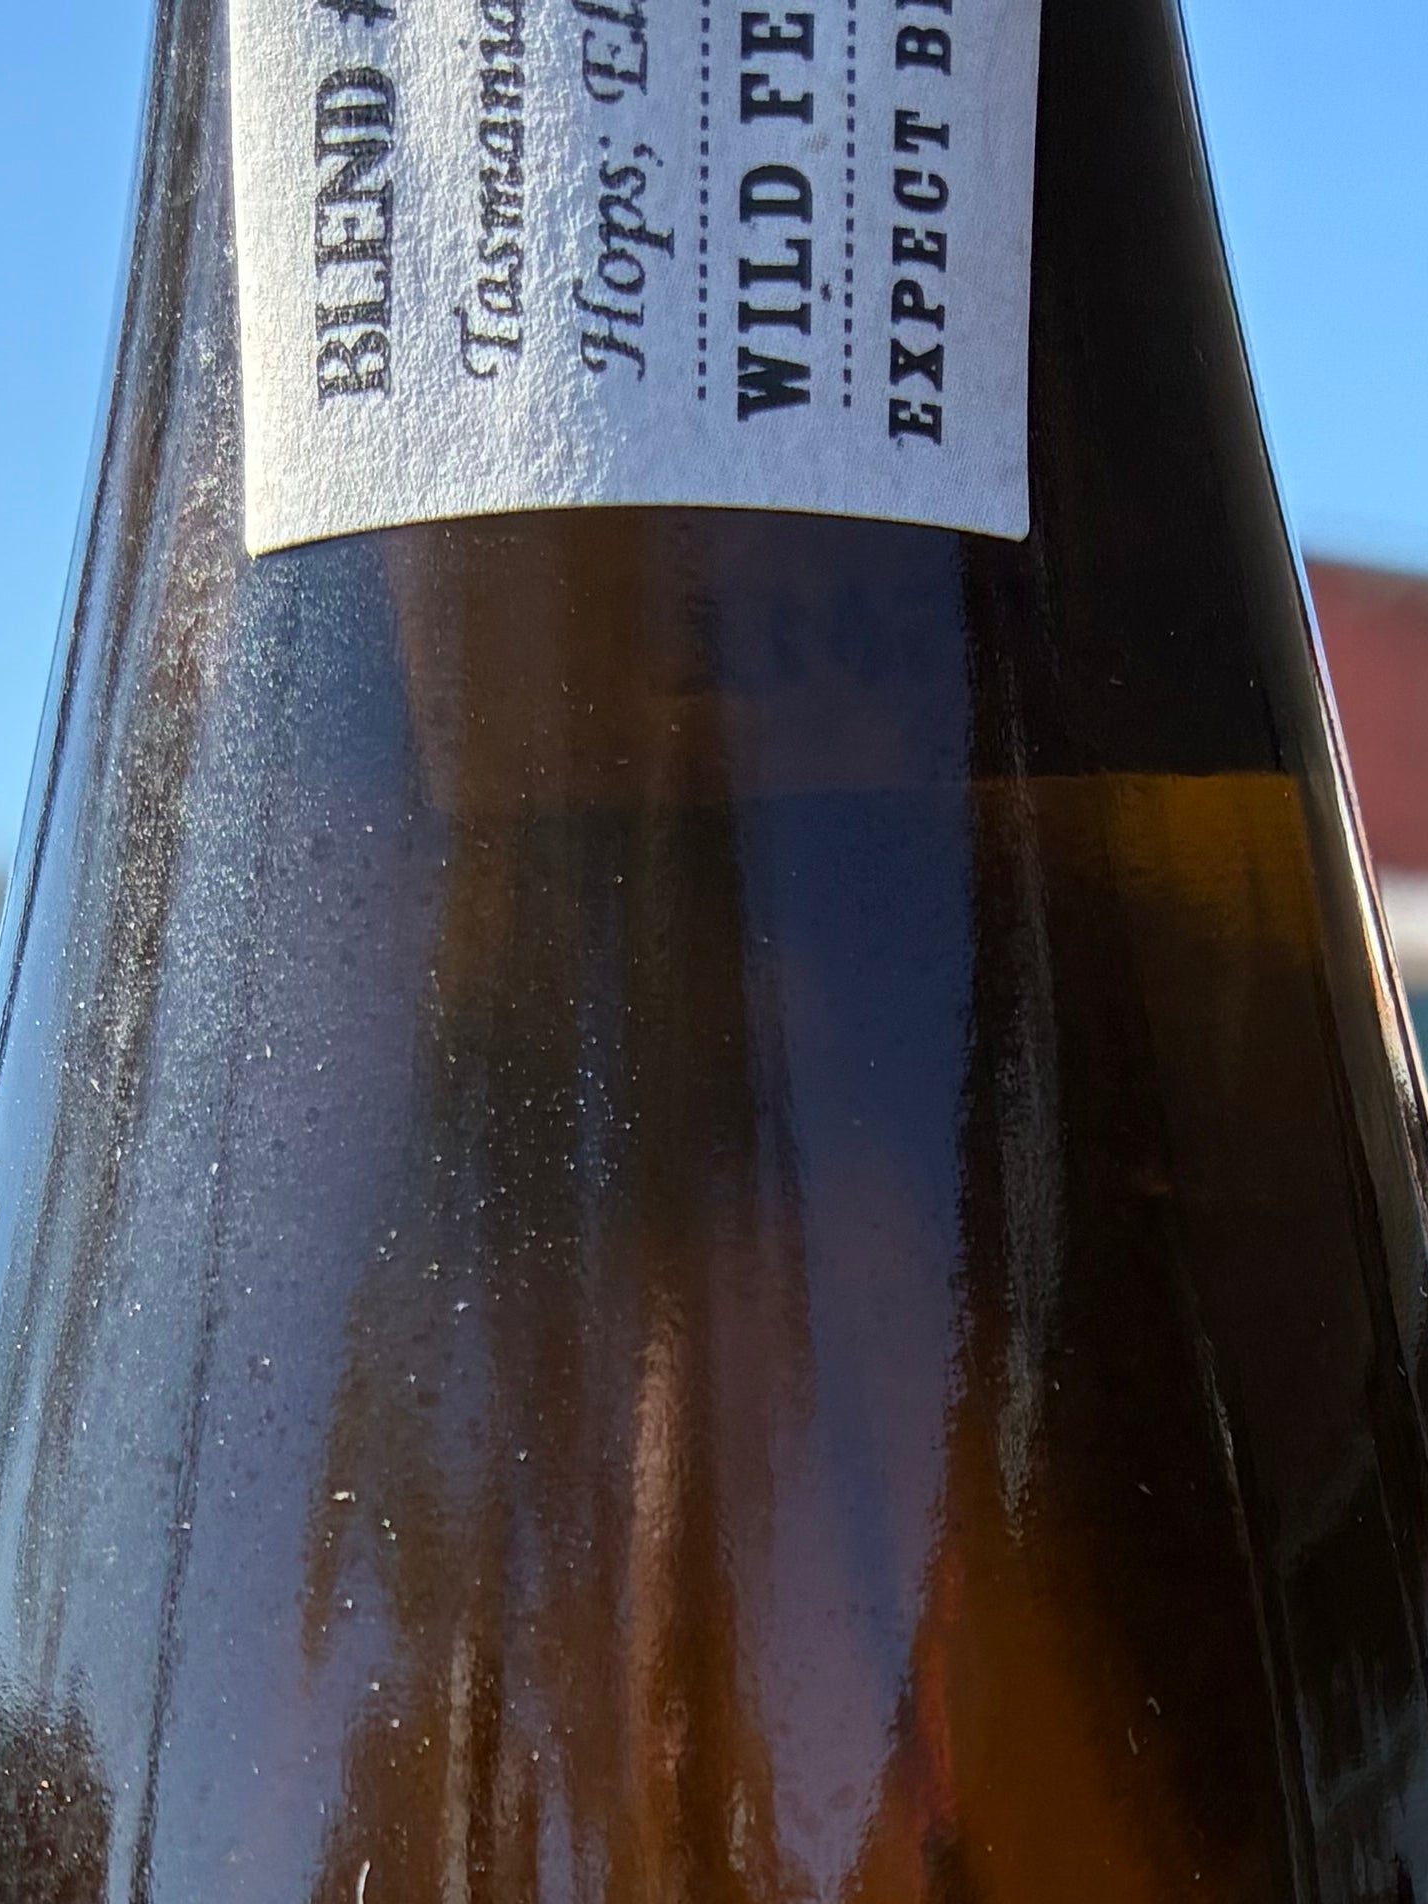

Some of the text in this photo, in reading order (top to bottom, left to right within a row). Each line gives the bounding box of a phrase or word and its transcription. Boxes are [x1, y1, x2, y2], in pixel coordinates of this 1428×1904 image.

[315, 66, 395, 403] BLEND
[573, 133, 678, 384] Hops;
[738, 163, 813, 422] WILD
[889, 108, 950, 447] EXPECT
